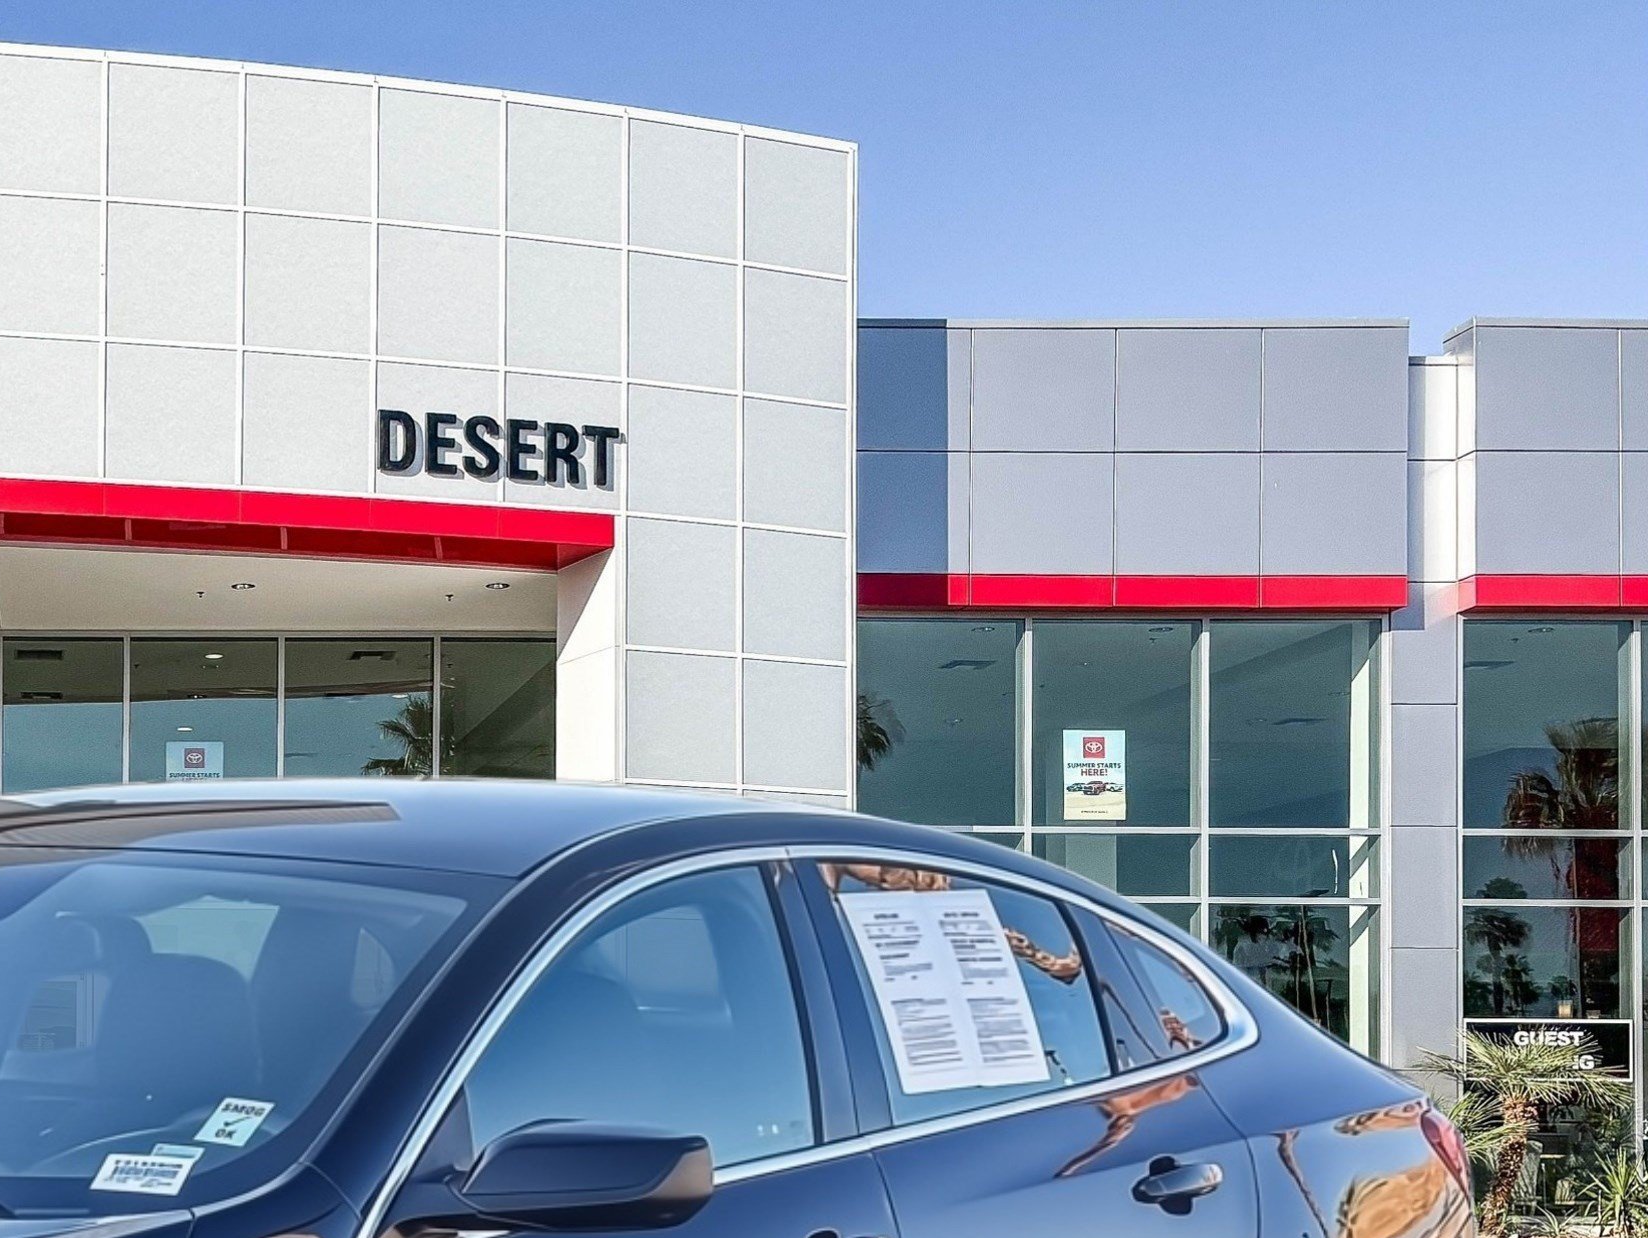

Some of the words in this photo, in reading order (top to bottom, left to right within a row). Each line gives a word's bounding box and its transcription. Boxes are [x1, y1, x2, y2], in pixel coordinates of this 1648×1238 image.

[377, 408, 621, 488] DESERT
[1080, 768, 1108, 776] HERE!
[1513, 1030, 1585, 1047] GUEST
[221, 1102, 266, 1117] SMOG
[214, 1128, 237, 1140] OK
